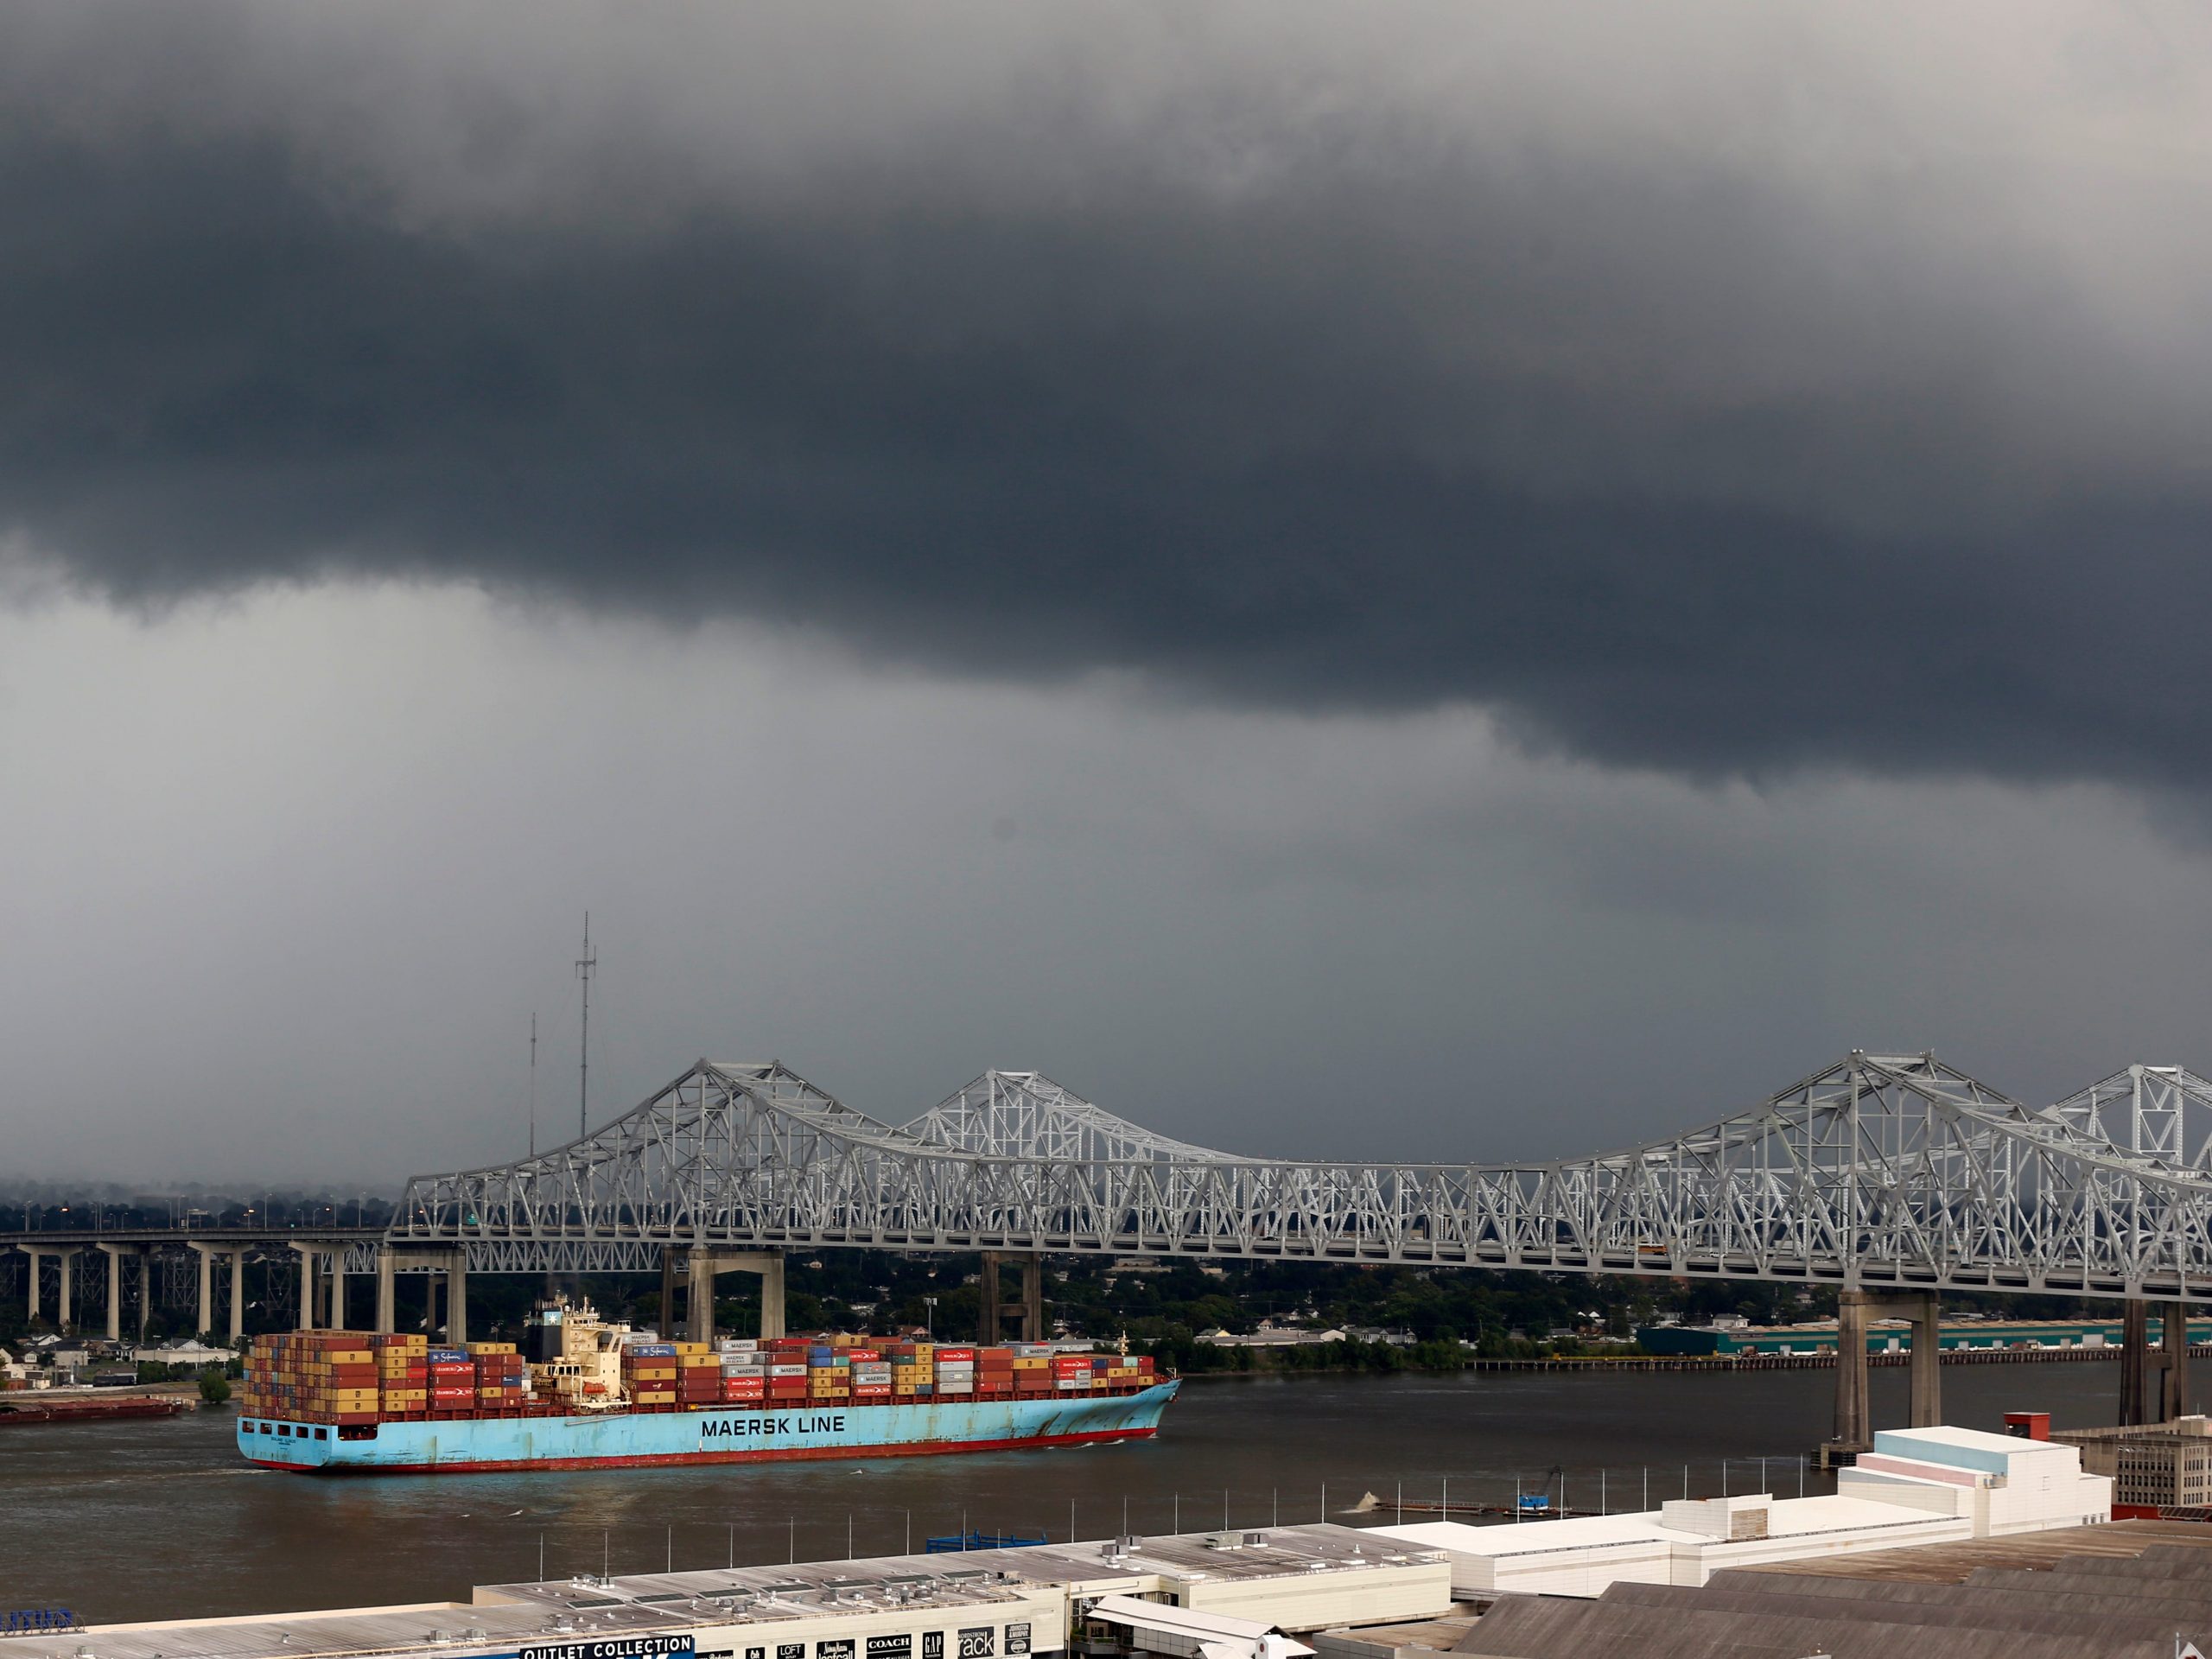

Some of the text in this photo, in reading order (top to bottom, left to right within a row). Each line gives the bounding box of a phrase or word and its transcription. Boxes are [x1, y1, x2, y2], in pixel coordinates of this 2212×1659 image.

[702, 1415, 845, 1437] MAERSK LINE
[524, 1637, 690, 1659] OUTLET COLLECTION
[780, 1645, 802, 1656] LOFT
[868, 1637, 910, 1649] COACH
[925, 1636, 942, 1654] GAP
[958, 1631, 994, 1656] rack
